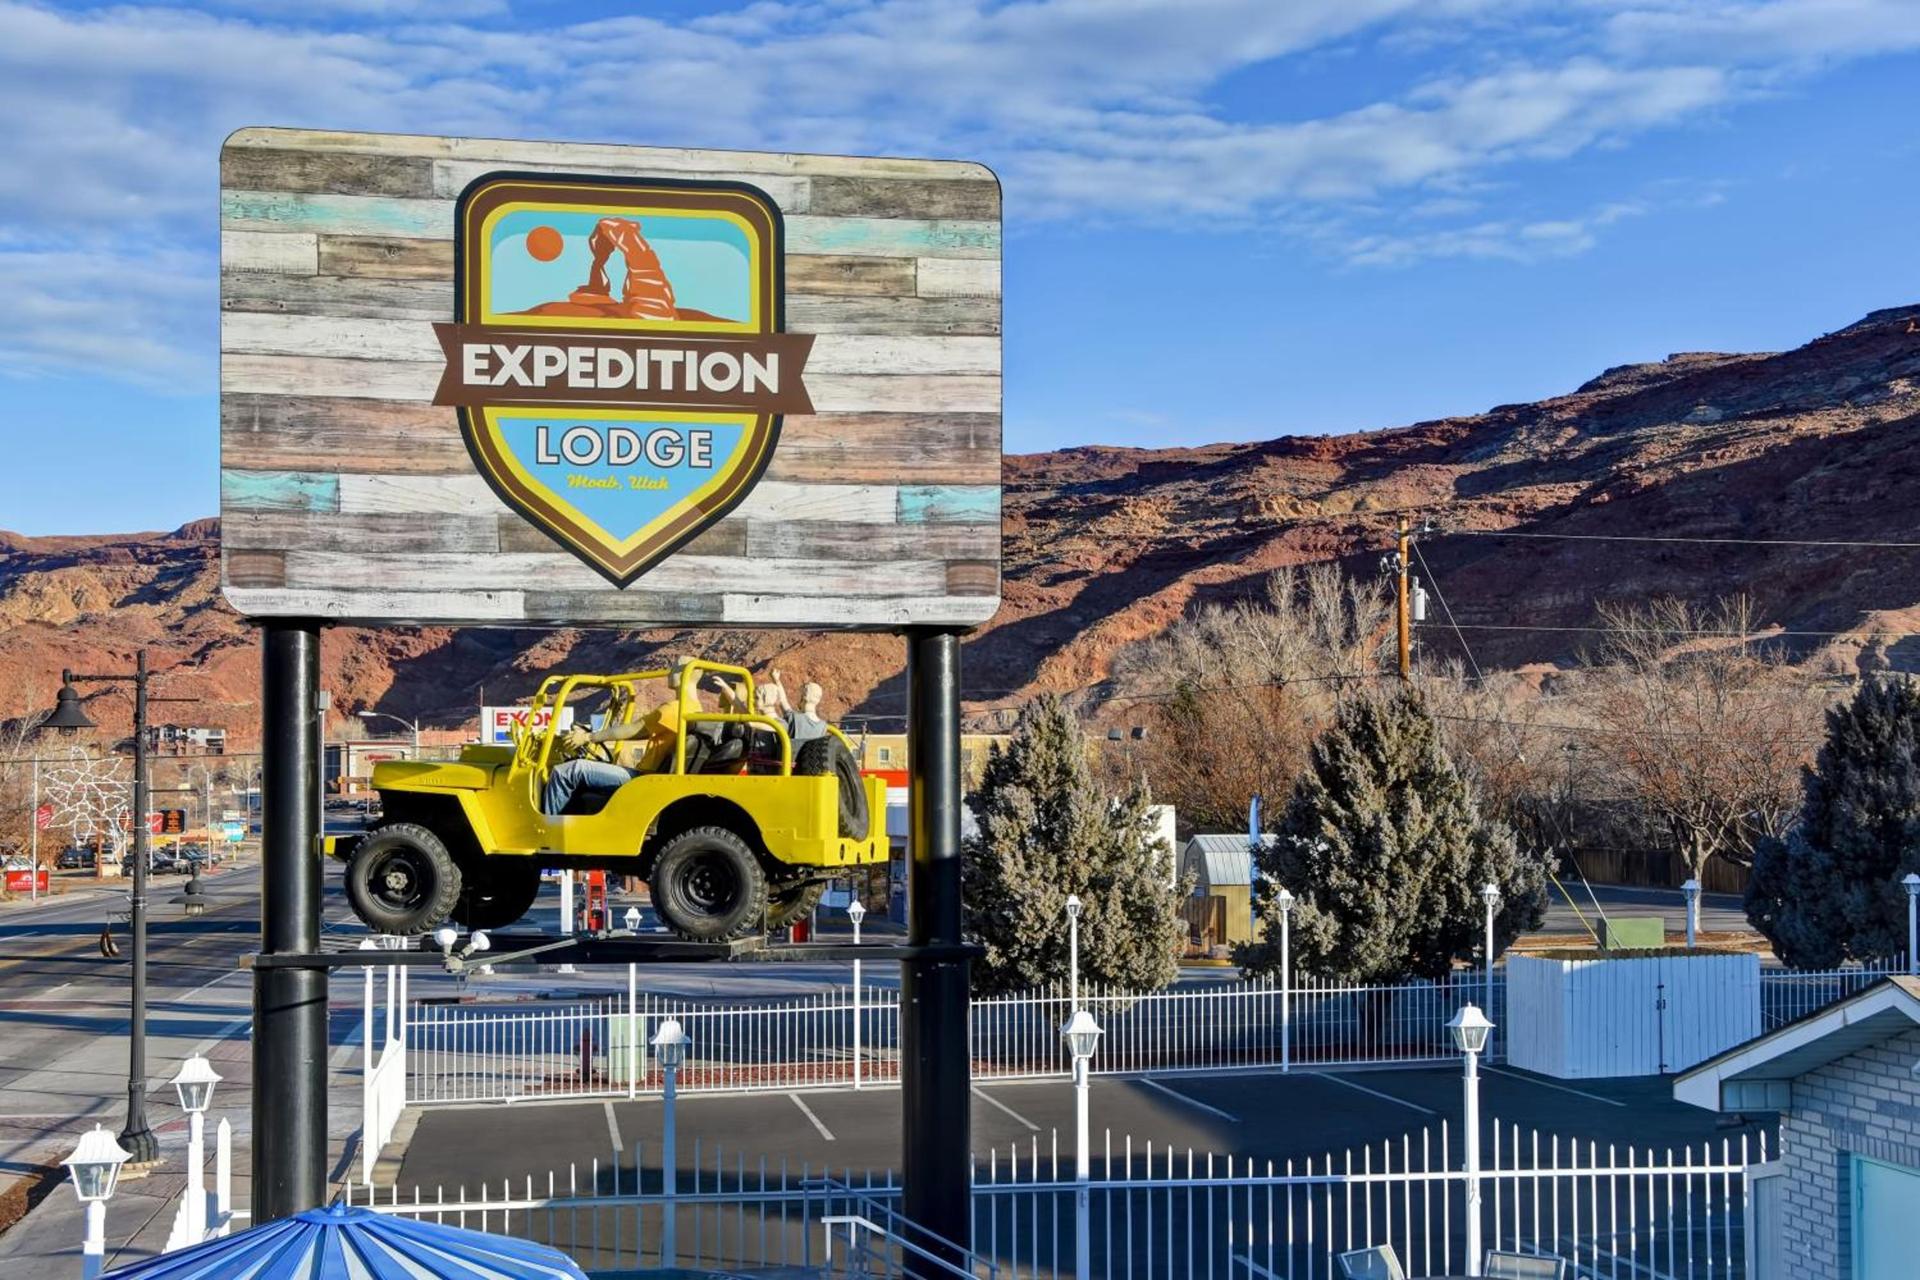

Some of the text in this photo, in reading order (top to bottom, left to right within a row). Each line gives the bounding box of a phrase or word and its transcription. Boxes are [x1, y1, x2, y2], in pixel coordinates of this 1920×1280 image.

[462, 343, 779, 394] EXPEDITION
[535, 425, 713, 469] LODGE
[566, 474, 669, 490] Moab, Utah
